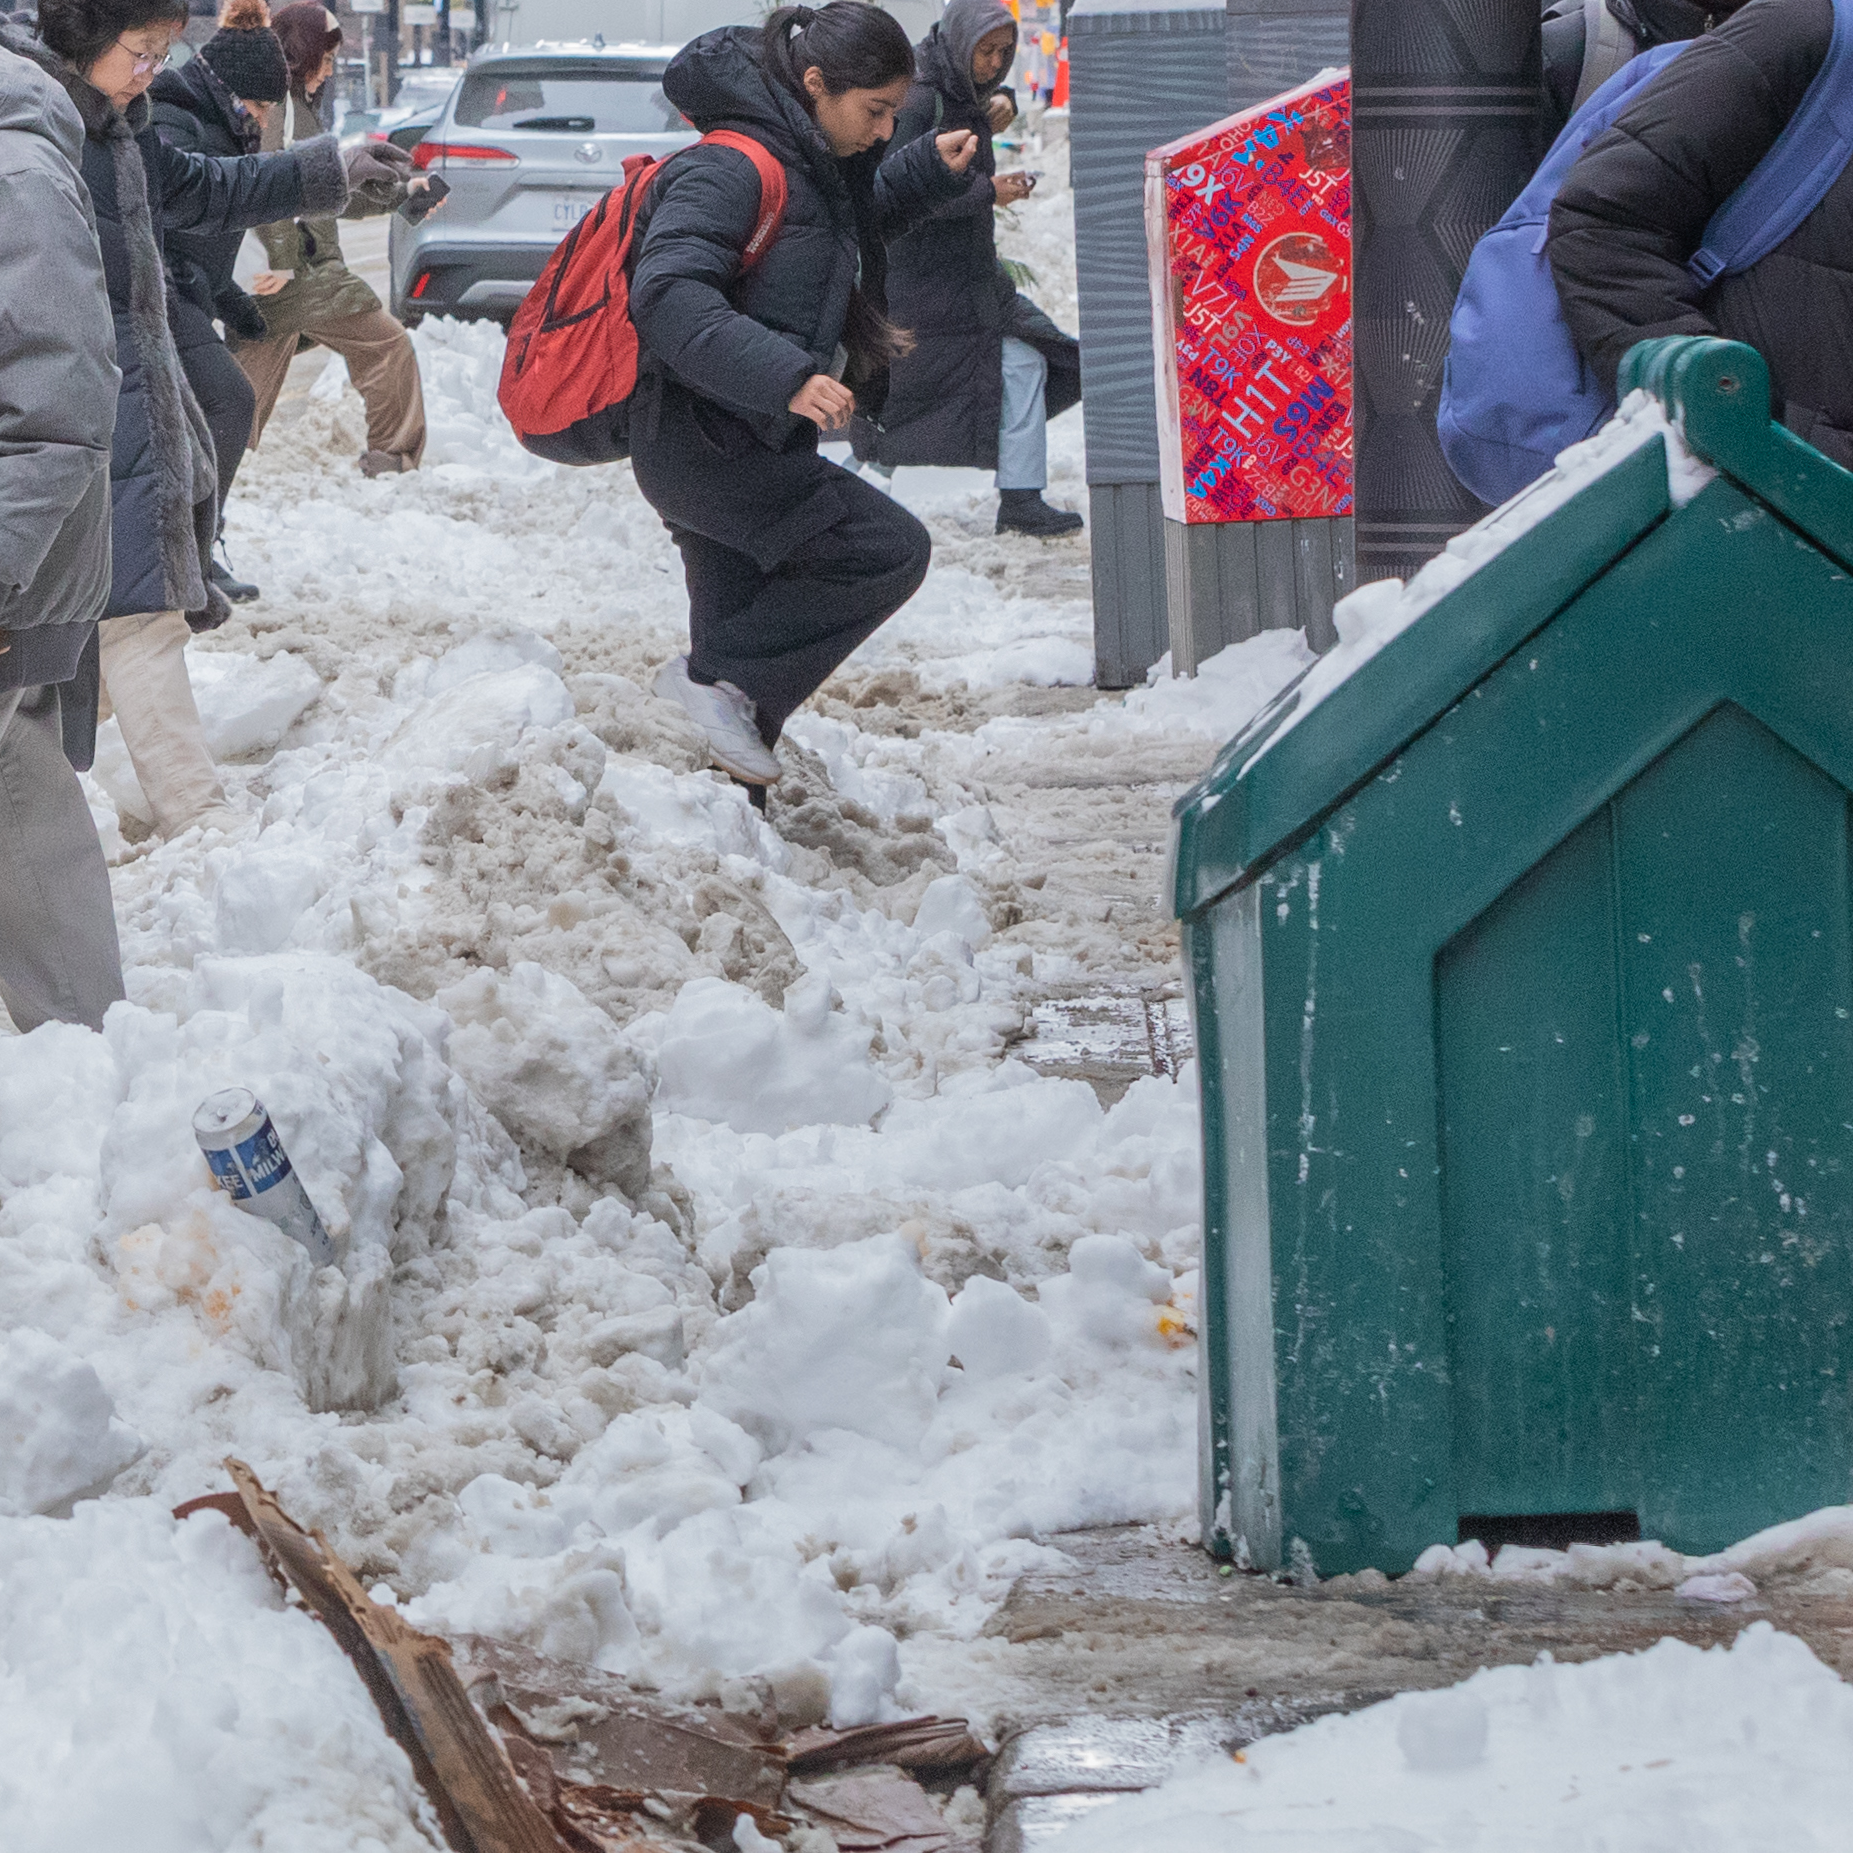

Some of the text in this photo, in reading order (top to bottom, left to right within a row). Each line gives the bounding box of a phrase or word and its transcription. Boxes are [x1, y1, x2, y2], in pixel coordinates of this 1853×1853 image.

[1211, 159, 1255, 194] J6V
[1261, 161, 1311, 209] B4E
[1298, 167, 1338, 195] J5T
[1193, 190, 1244, 240] V6K
[1169, 221, 1207, 264] X1A
[1191, 268, 1238, 319] V7J
[1182, 301, 1222, 335] J5T
[1209, 309, 1254, 349] V9L
[1201, 345, 1244, 390] T9K
[1265, 338, 1293, 365] P3Y
[1220, 359, 1292, 439] H1T
[1272, 374, 1336, 445] M6S
[1211, 424, 1251, 468] T9K
[1245, 431, 1290, 465] J6V
[1291, 429, 1352, 489] B4E
[1185, 453, 1233, 500] K4A
[1289, 465, 1338, 511] G3N
